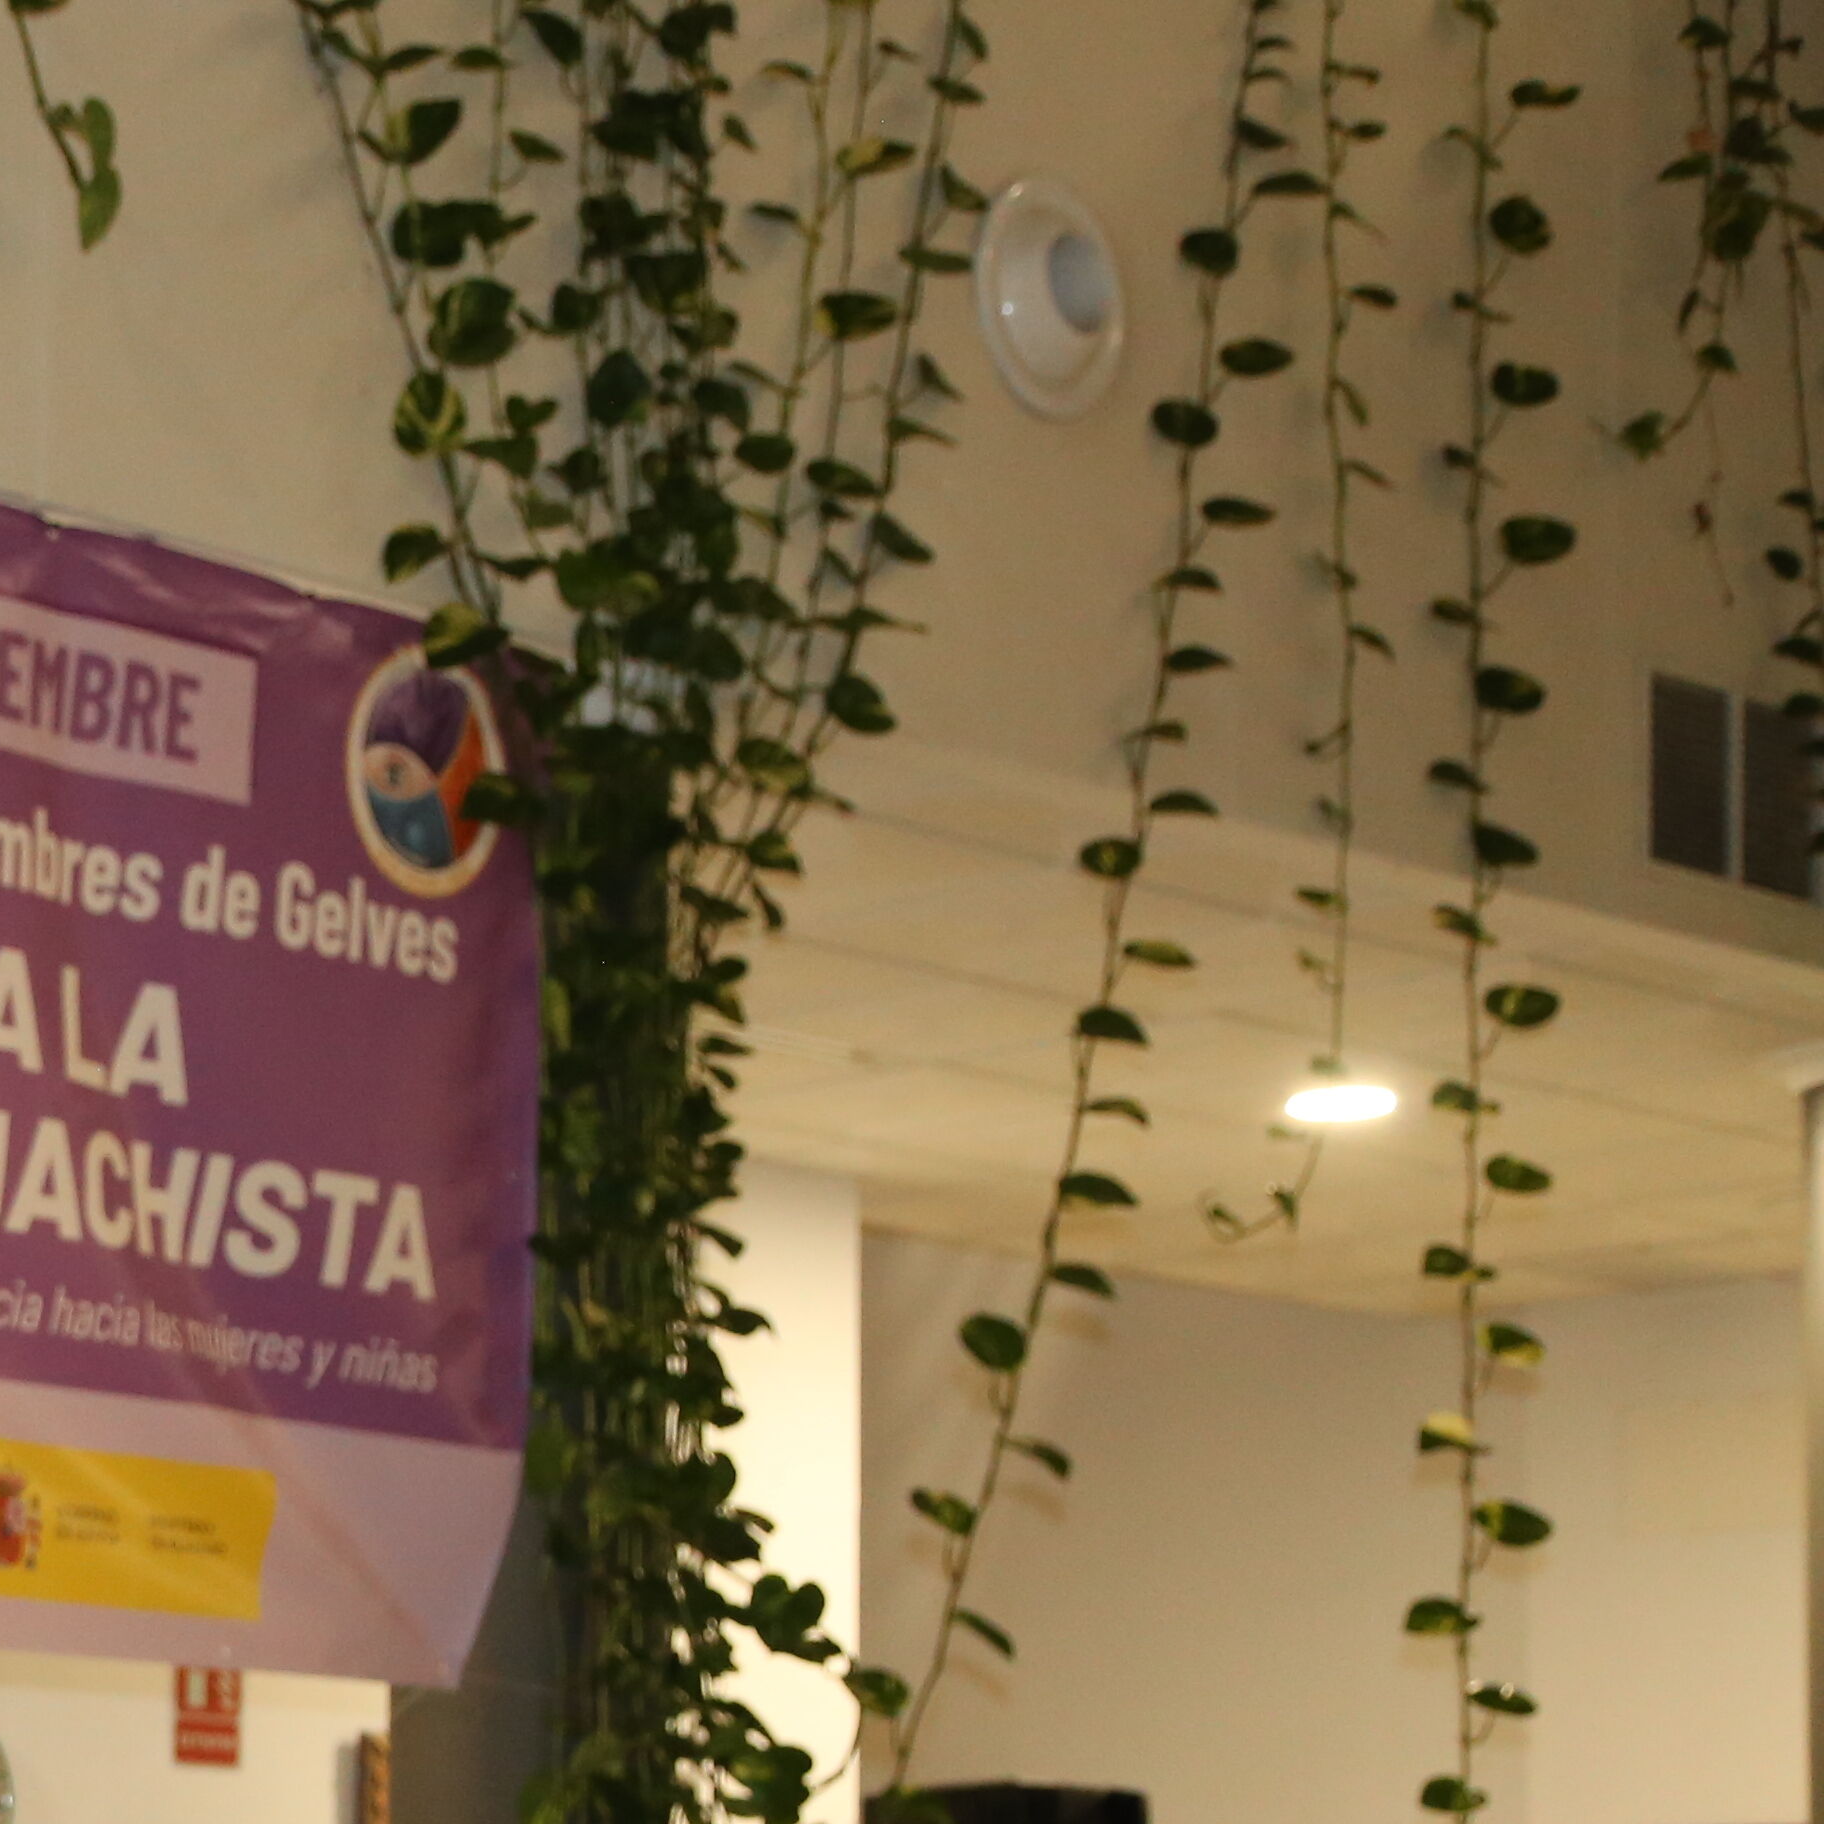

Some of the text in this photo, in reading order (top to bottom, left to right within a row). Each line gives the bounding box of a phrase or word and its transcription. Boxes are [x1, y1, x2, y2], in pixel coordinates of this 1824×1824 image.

[180, 845, 261, 939] de
[273, 860, 460, 985] Gelves
[60, 962, 190, 1107] LA
[49, 1284, 140, 1347] hacia
[306, 1340, 337, 1391] y
